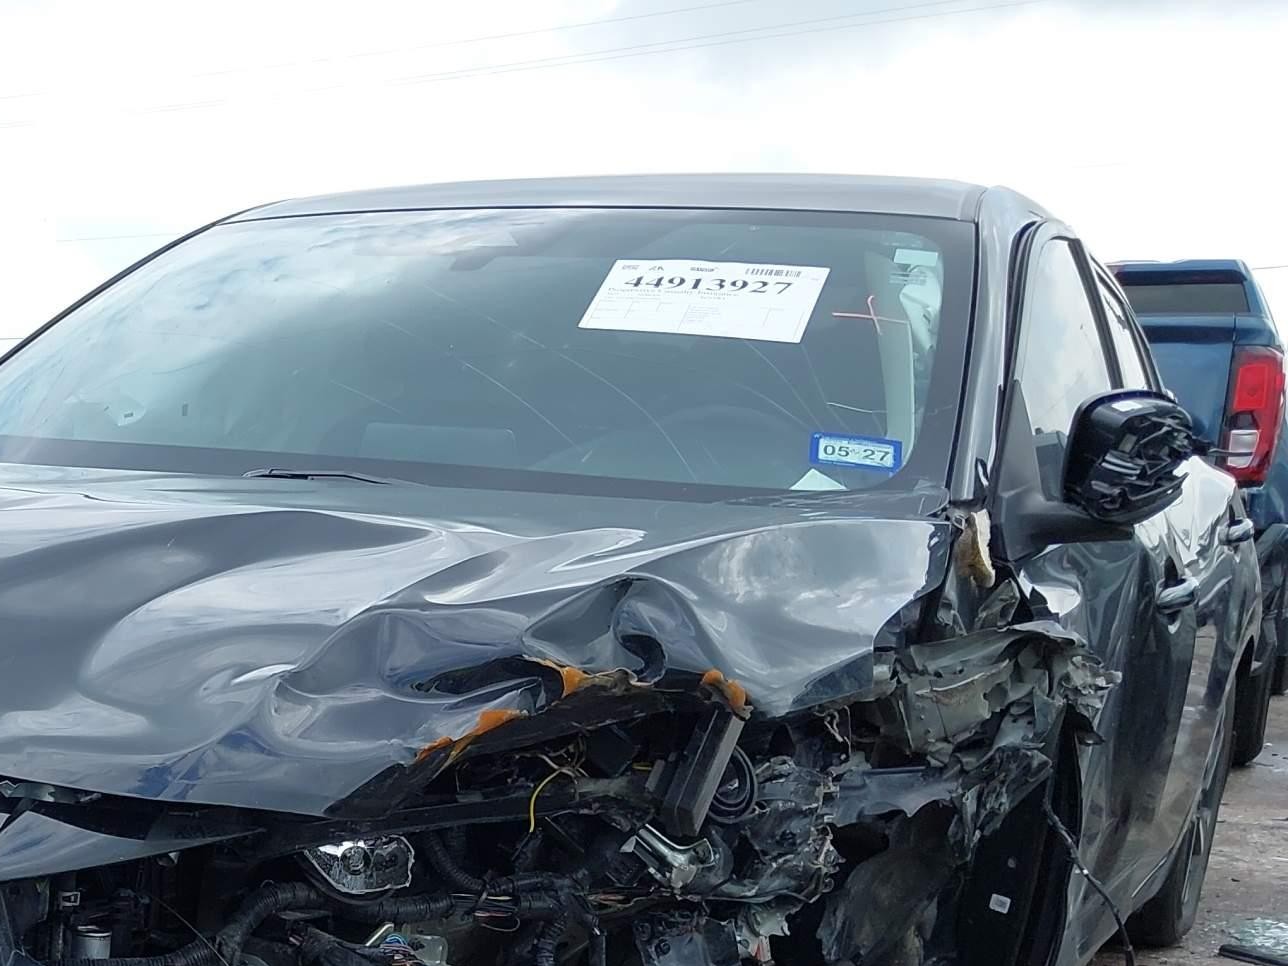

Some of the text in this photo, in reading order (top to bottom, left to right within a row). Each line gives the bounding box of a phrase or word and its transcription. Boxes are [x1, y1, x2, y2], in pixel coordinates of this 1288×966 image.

[623, 275, 795, 296] 44913927
[823, 444, 890, 462] 05 27
